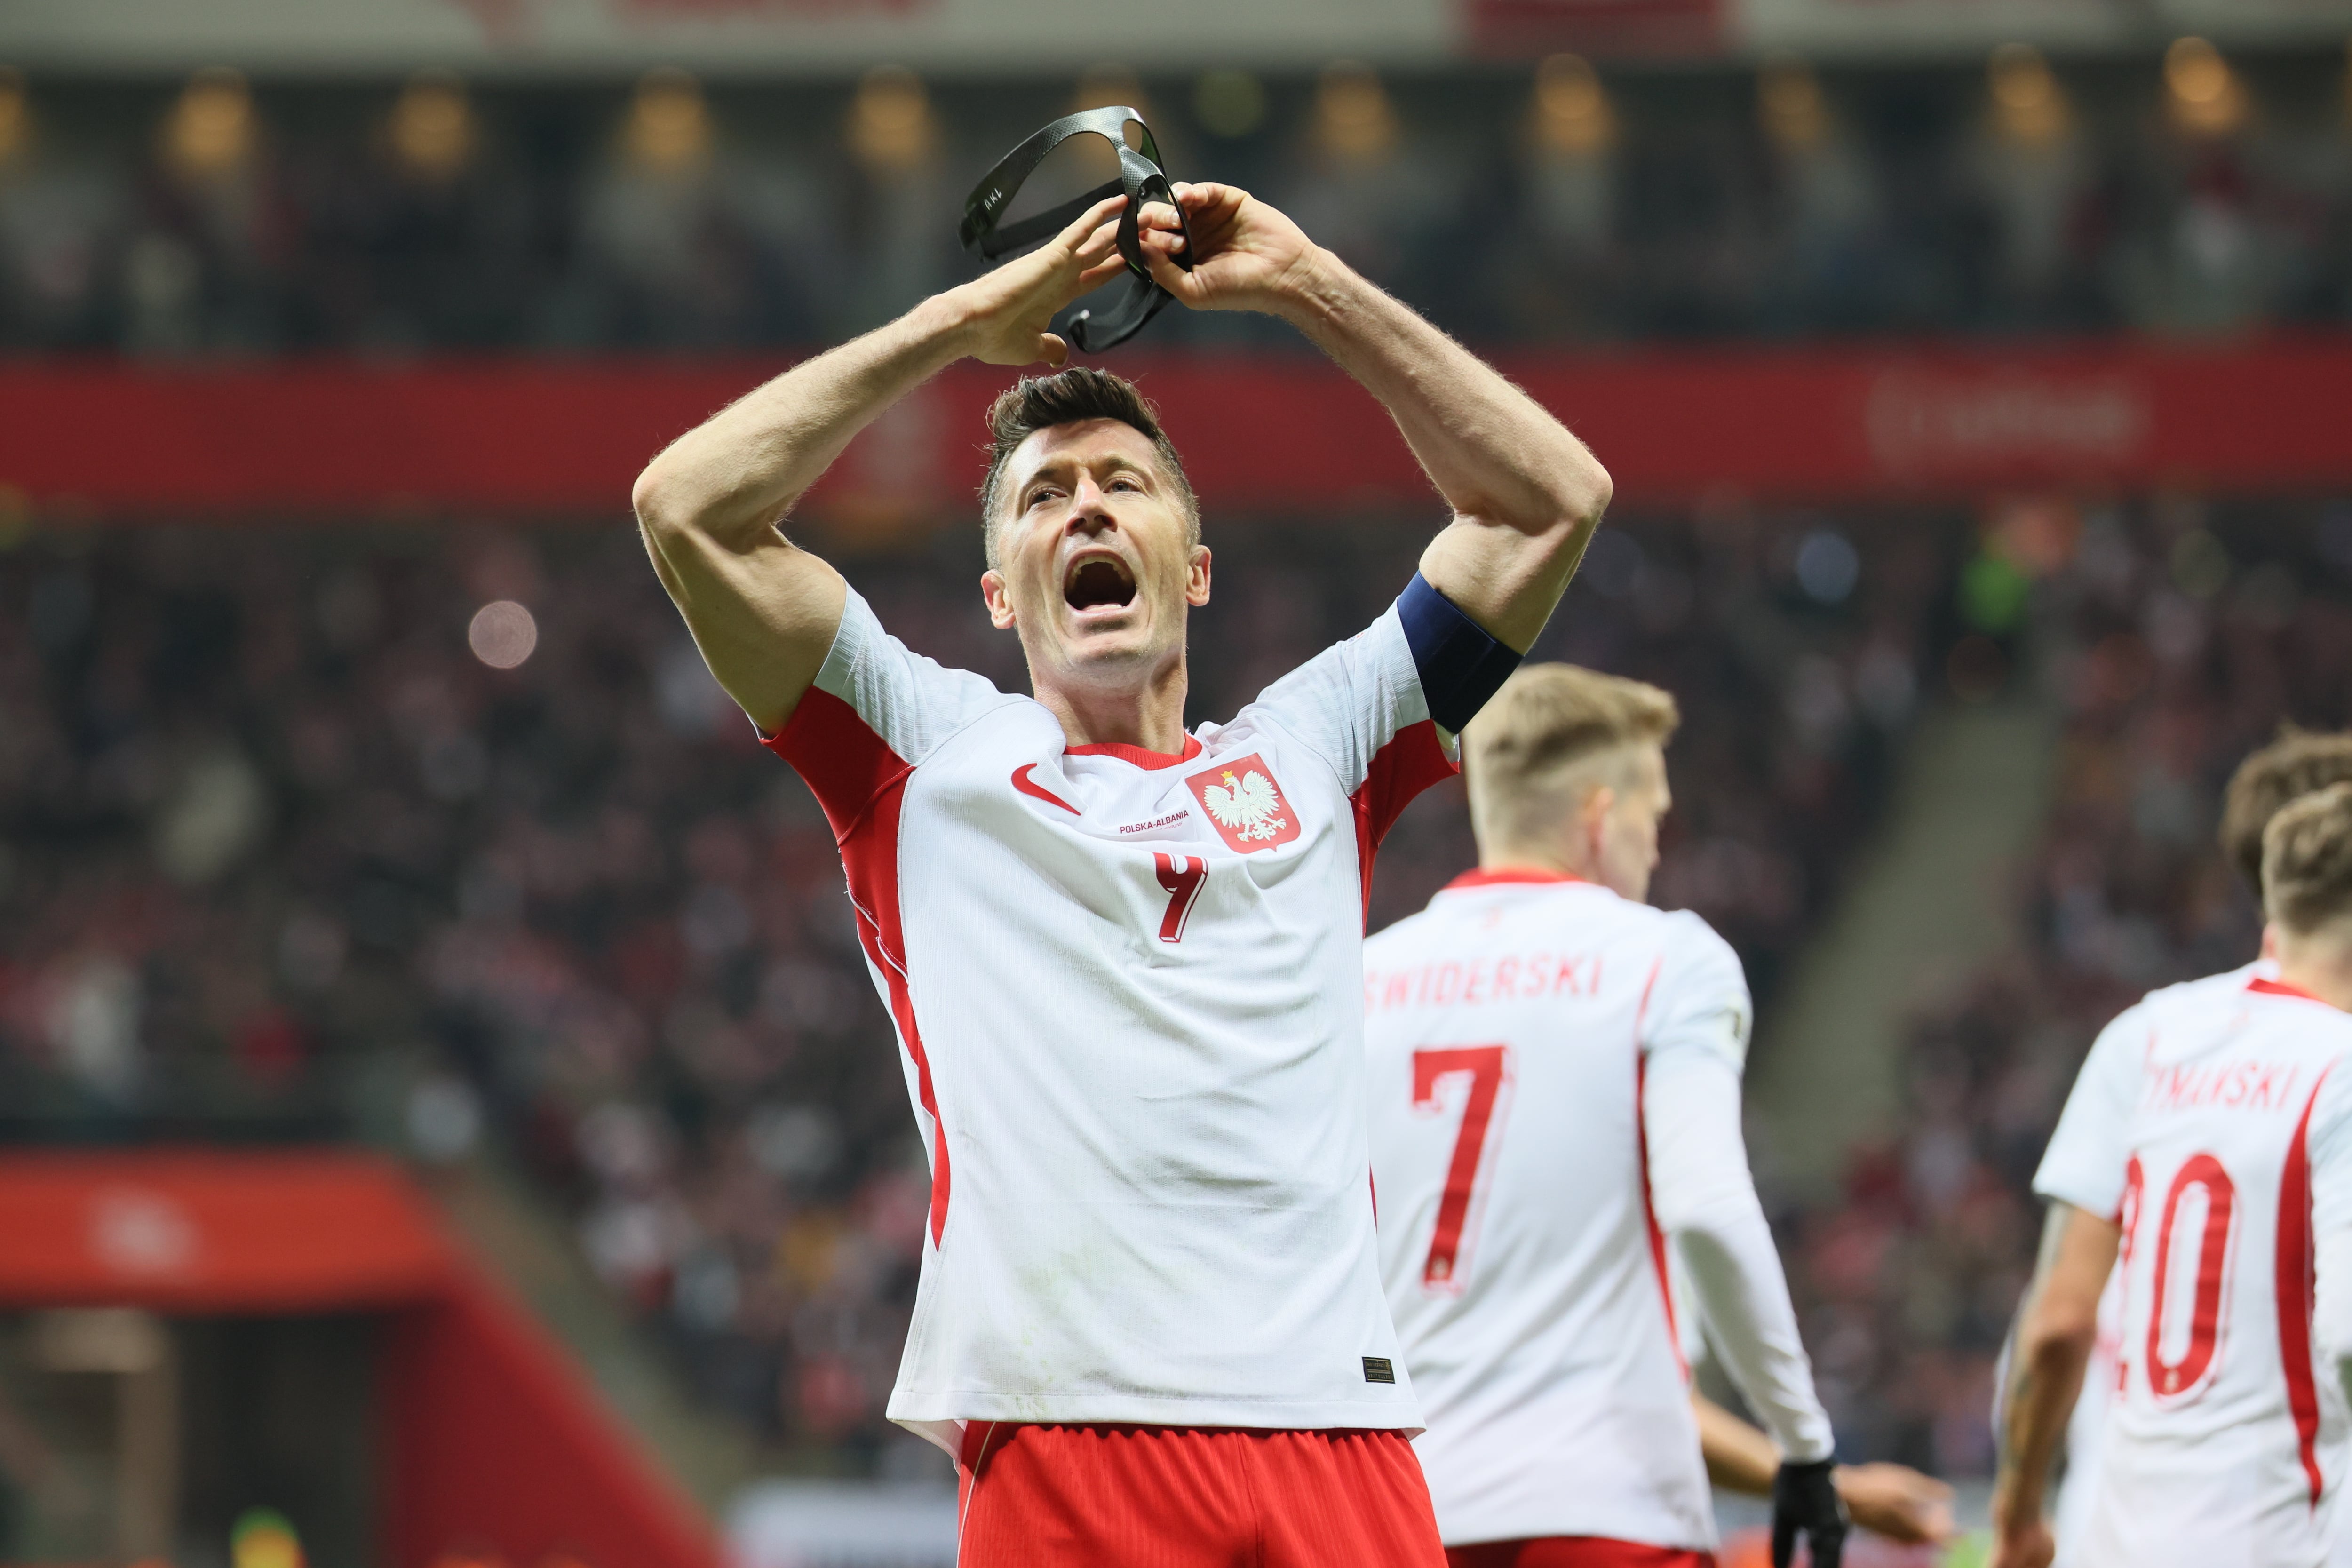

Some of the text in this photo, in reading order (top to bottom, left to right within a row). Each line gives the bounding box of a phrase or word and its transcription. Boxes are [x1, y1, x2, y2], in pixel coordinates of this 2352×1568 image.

[1120, 809, 1189, 834] POLSKA-ALBANIA
[1152, 852, 1208, 943] 9
[1412, 1045, 1514, 1294] 7
[2120, 1153, 2239, 1401] 0
